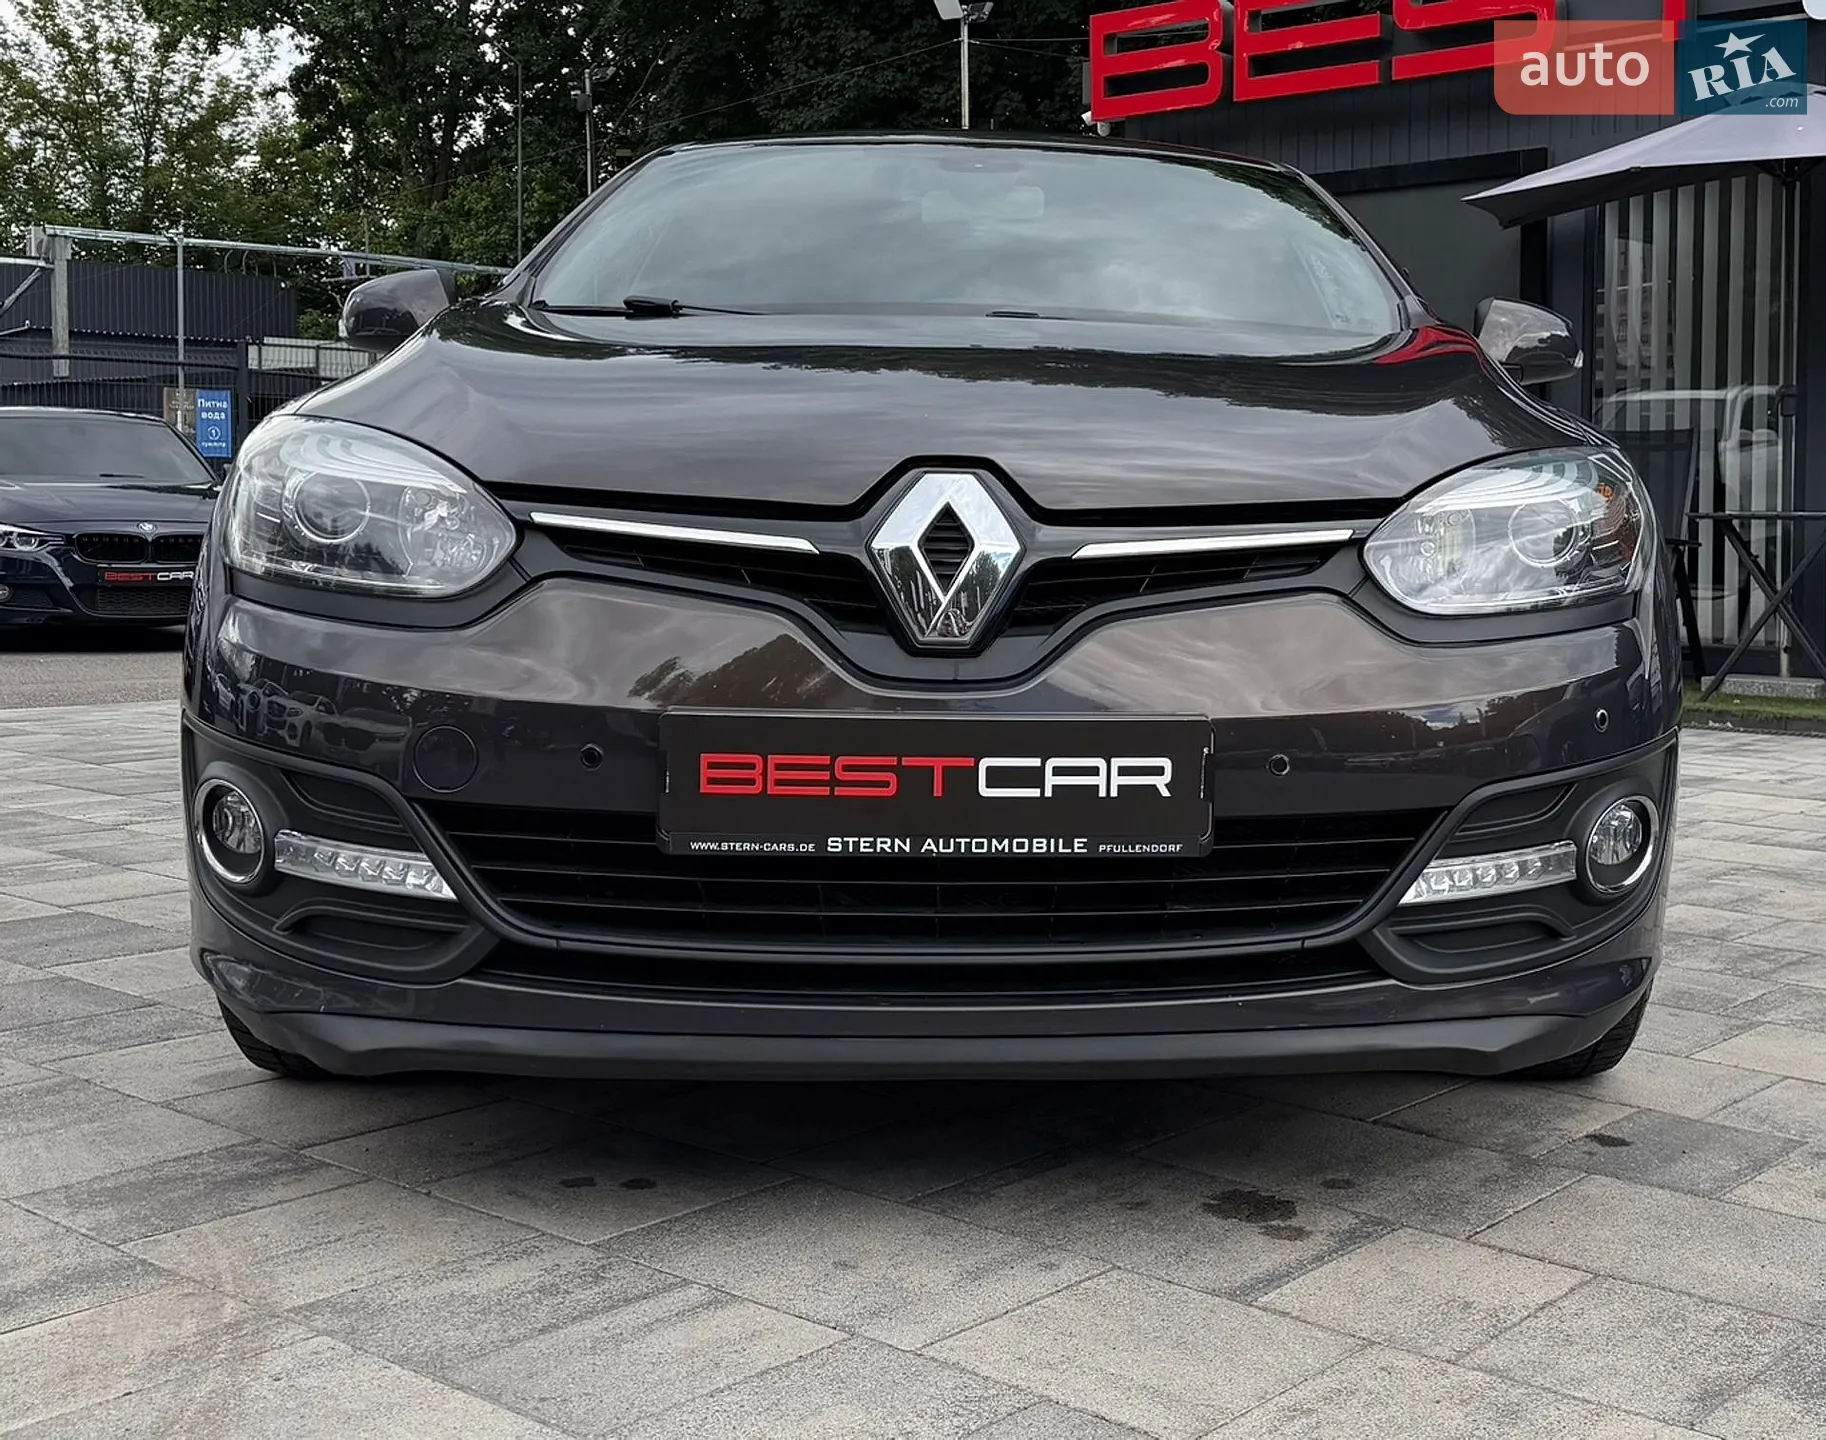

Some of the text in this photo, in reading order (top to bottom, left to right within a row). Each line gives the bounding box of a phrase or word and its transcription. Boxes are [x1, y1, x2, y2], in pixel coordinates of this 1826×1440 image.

[699, 753, 1173, 798] BESTCAR
[690, 836, 1183, 853] WWW.STERN-CARS.DE STERN AUTOMOBILE PFULLENDORF
